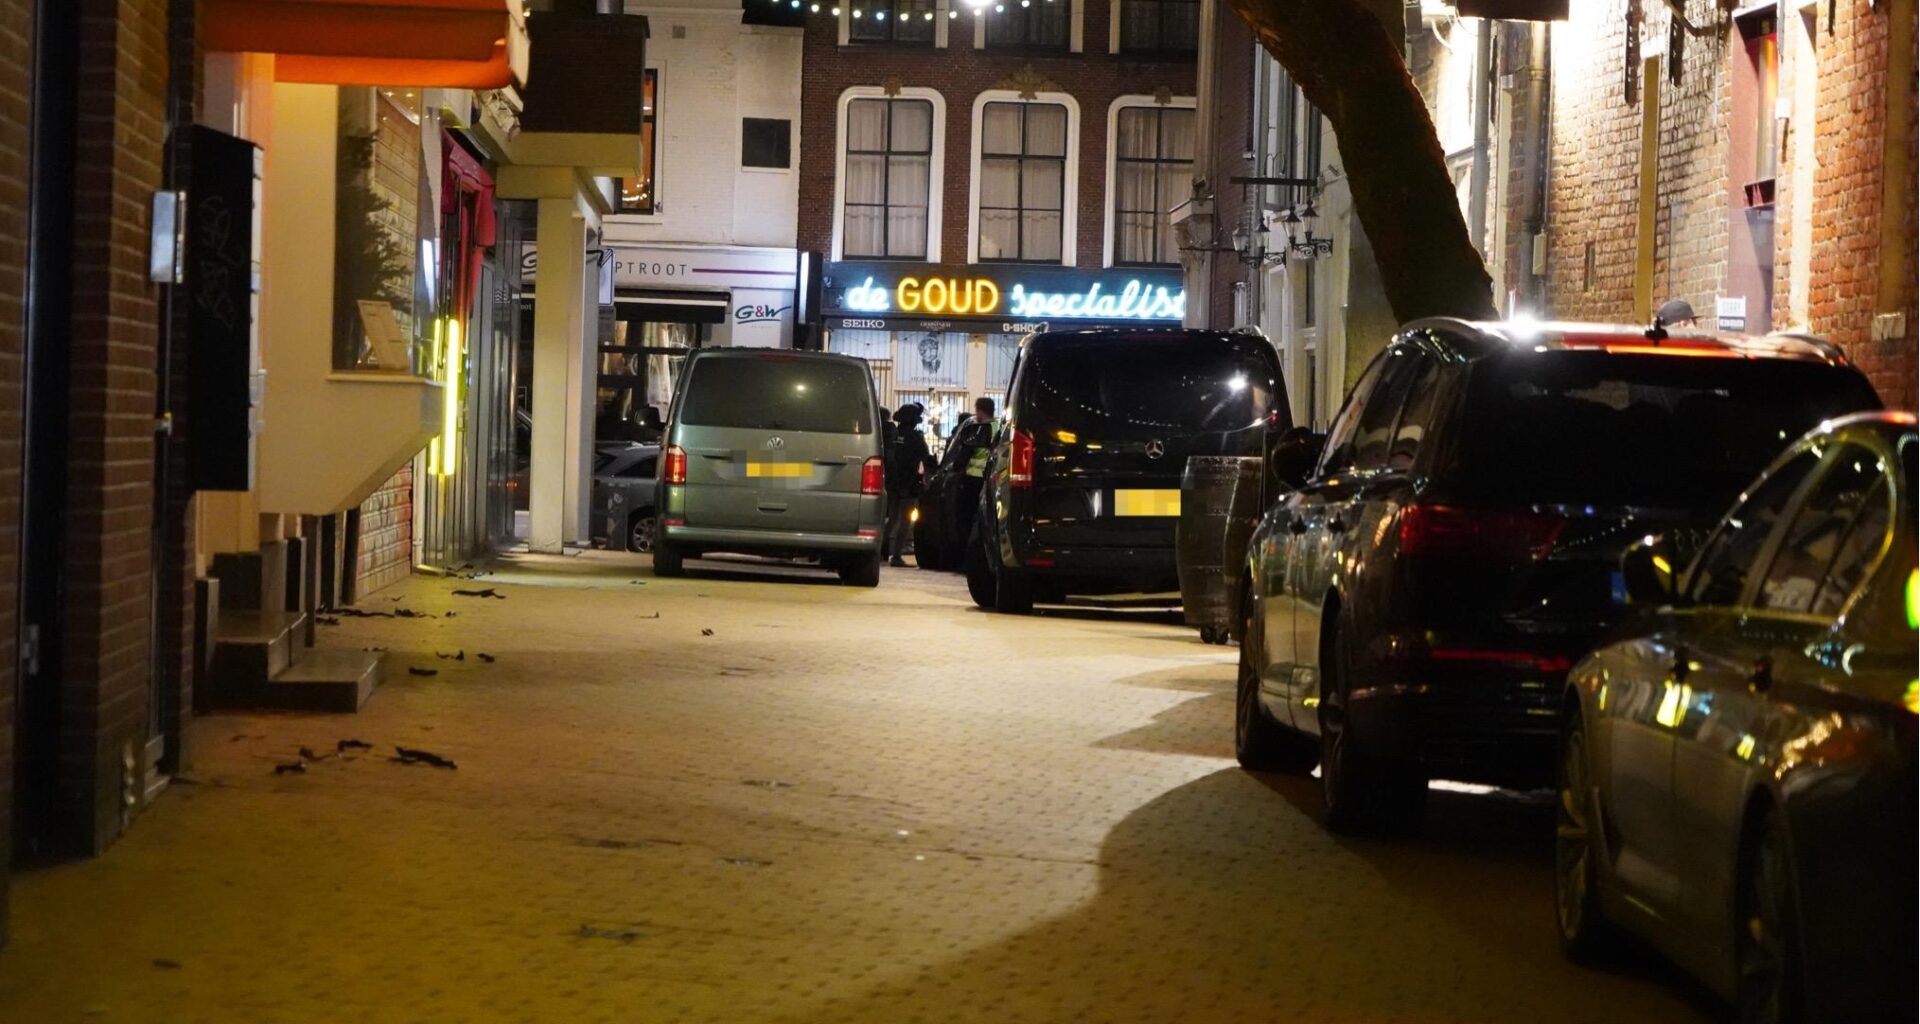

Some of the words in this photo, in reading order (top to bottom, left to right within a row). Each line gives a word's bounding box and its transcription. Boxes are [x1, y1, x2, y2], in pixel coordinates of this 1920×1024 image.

[847, 276, 890, 311] de
[897, 276, 999, 313] GOUD
[735, 304, 792, 321] G&W
[842, 318, 886, 329] SEIKO
